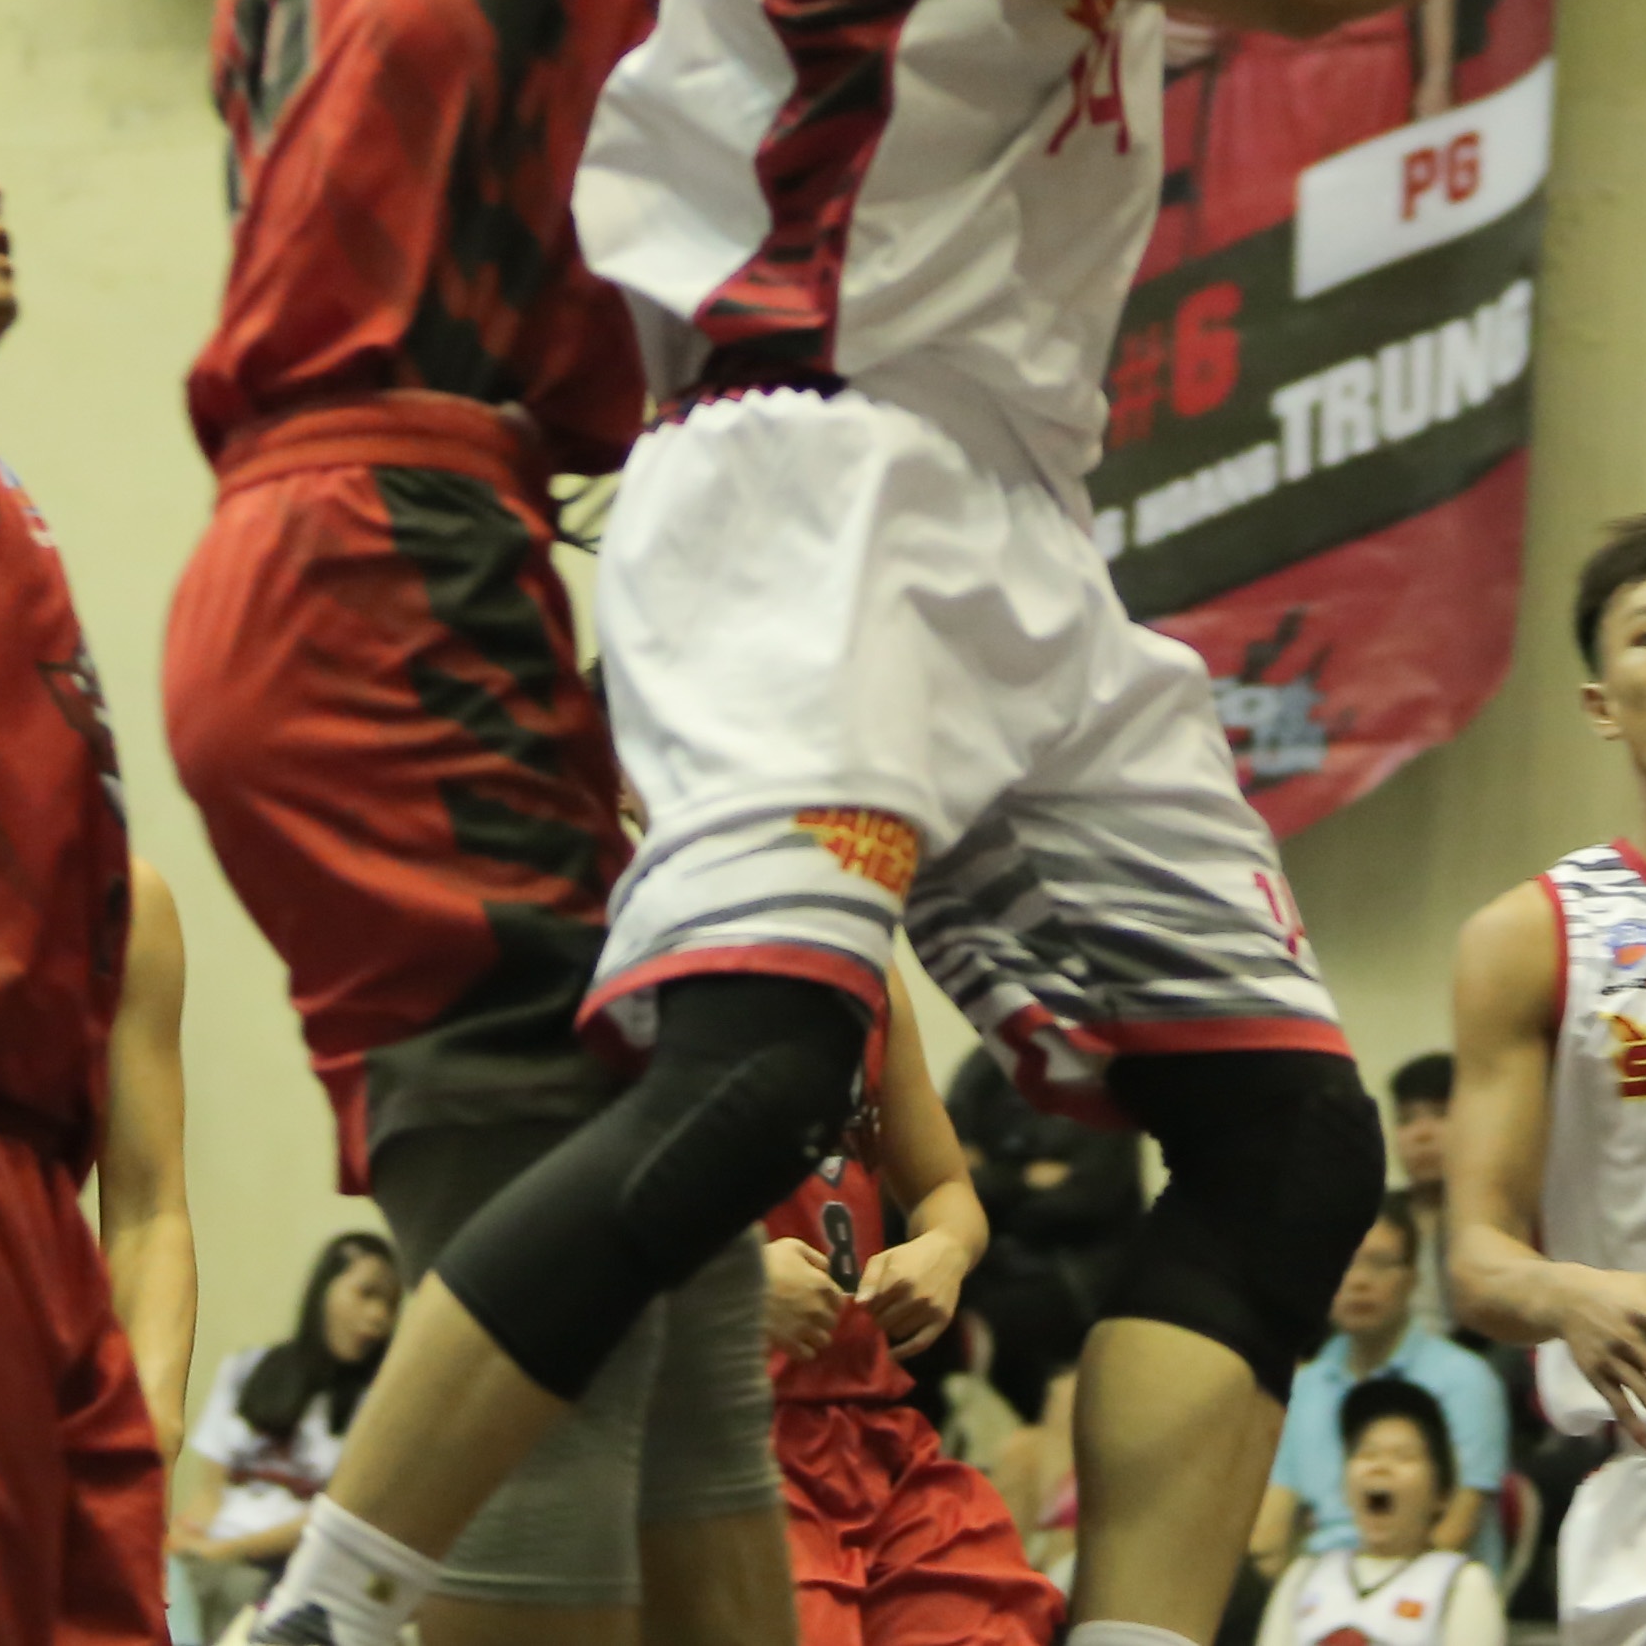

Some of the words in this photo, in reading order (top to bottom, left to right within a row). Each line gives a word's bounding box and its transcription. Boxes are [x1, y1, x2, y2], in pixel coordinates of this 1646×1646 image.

[1400, 131, 1482, 222] PG
[1107, 281, 1243, 449] #6
[820, 1201, 861, 1295] 8
